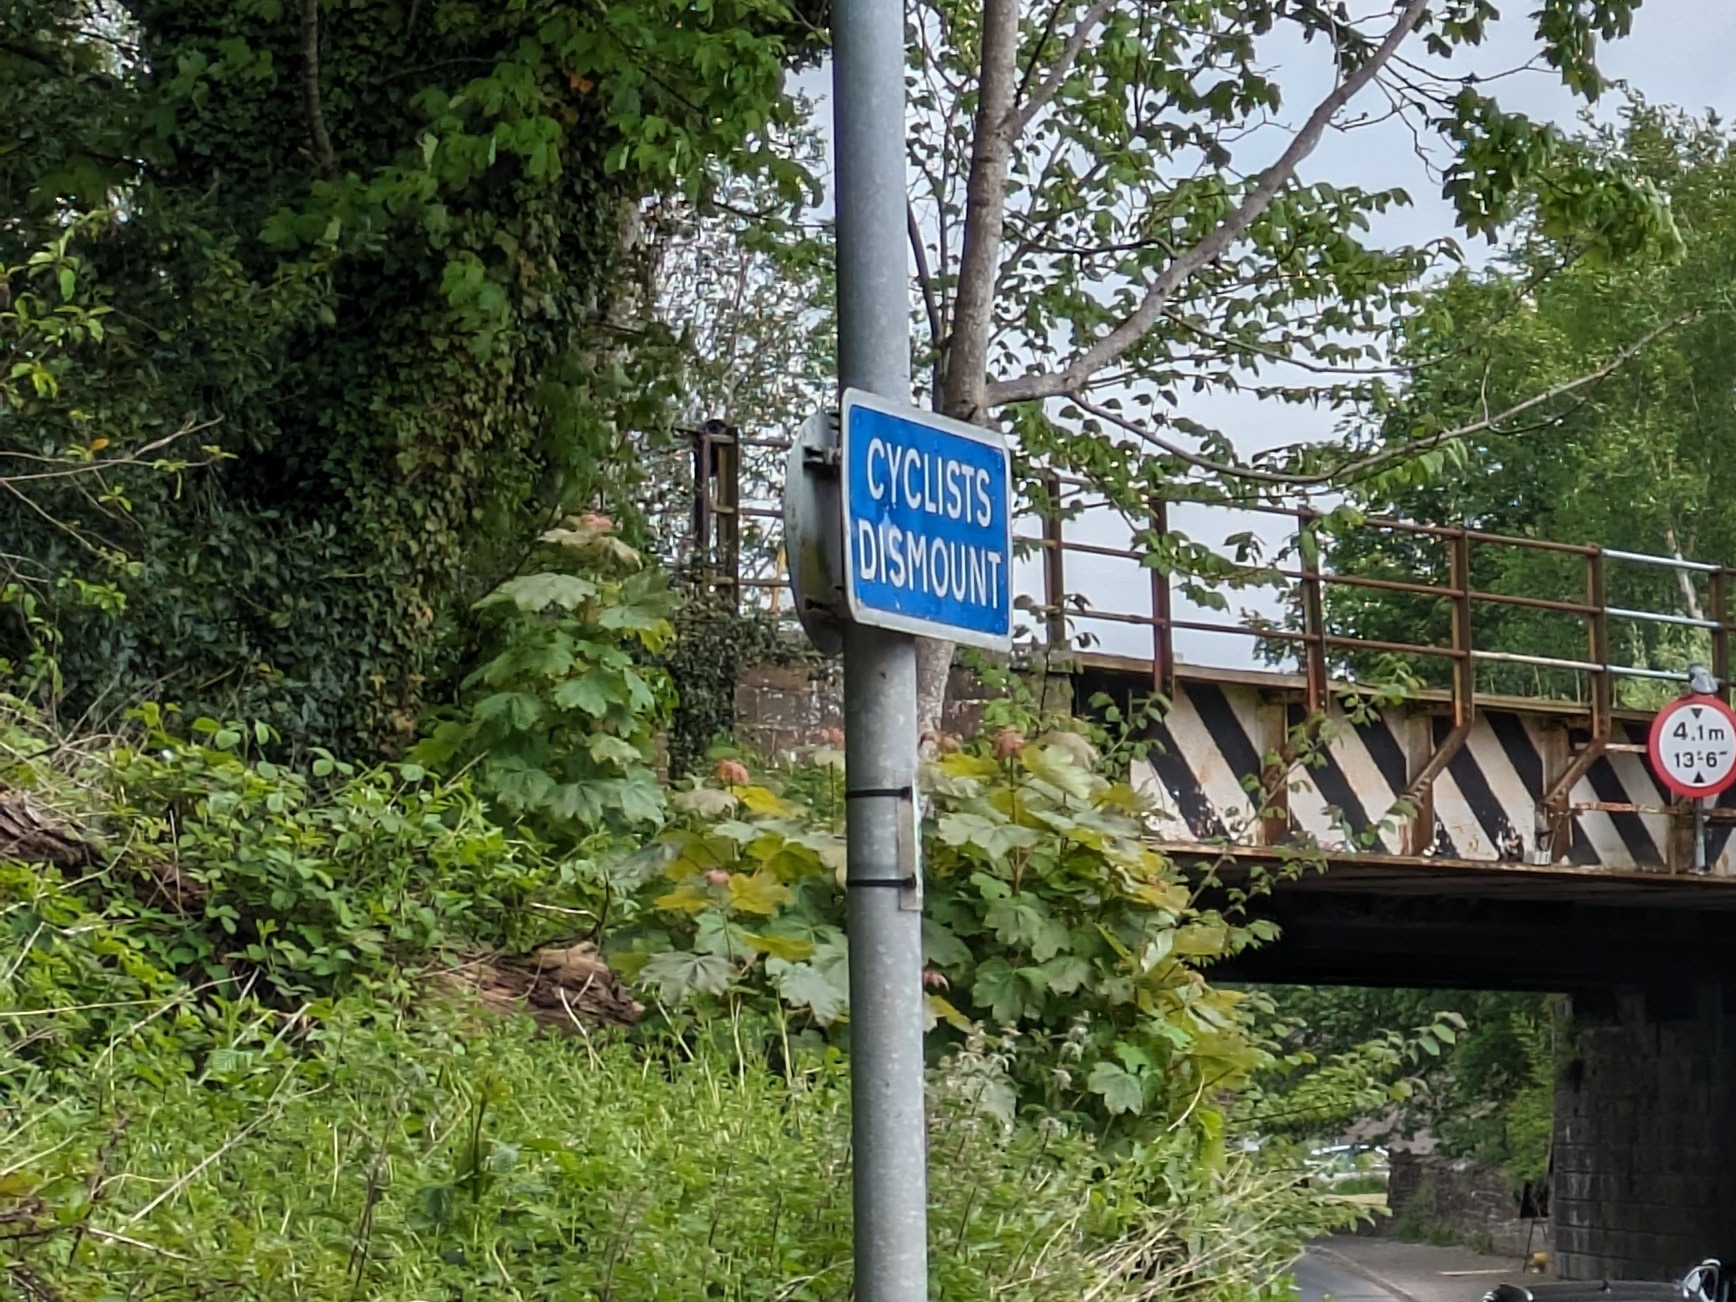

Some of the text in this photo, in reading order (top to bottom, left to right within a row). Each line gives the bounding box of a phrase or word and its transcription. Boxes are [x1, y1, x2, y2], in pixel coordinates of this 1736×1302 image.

[866, 438, 991, 528] CYCLISTS
[857, 518, 1002, 609] DISMOUNT
[1672, 721, 1725, 742] 4.1m
